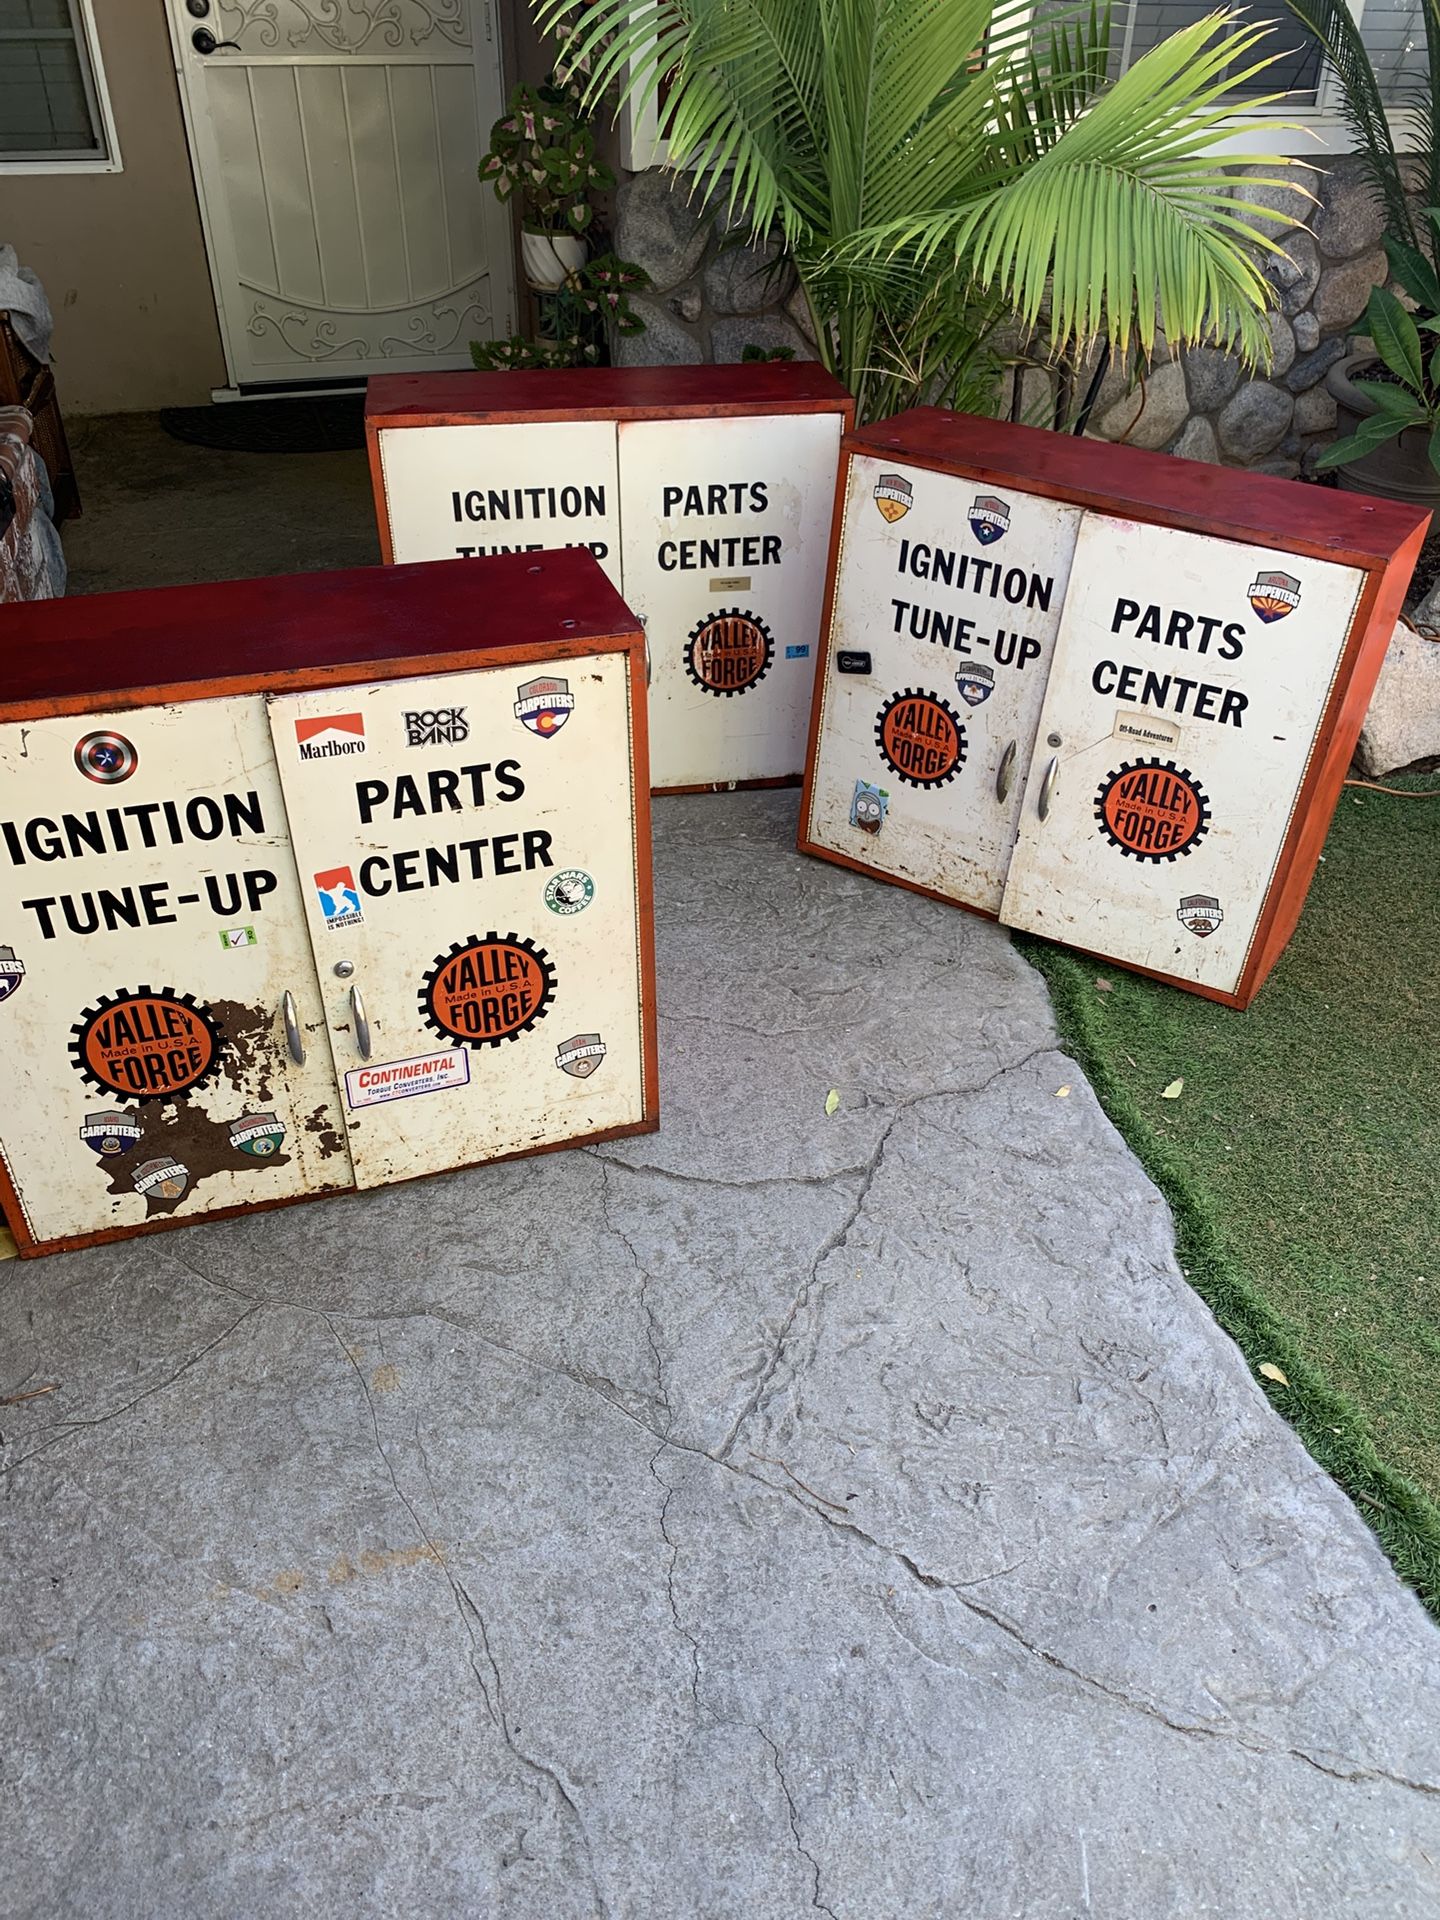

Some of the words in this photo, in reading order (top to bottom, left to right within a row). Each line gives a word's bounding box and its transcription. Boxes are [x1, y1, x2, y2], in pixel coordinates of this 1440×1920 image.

[452, 485, 606, 522] IGNITION
[663, 481, 769, 517] PARTS
[875, 486, 912, 508] CARPENTERS
[970, 508, 1009, 531] CARPENTERS
[657, 535, 782, 571] CENTER
[898, 539, 1054, 612] IGNITION
[1248, 584, 1299, 608] CARPENTERS
[700, 620, 758, 651] VALLEY
[891, 598, 1042, 670] TUNE-UP
[1111, 598, 1246, 660] PARTS
[702, 656, 758, 686] FORGE
[514, 695, 574, 717] CARPENTERS
[1092, 660, 1249, 728] CENTER
[404, 707, 469, 731] ROCK
[891, 728, 913, 739] Made
[894, 703, 952, 743] VALLEY
[299, 739, 366, 760] Marlboro
[407, 726, 469, 746] BAND
[1142, 730, 1174, 743] Adventures
[891, 736, 949, 774] FORGE
[356, 759, 526, 824] PARTS
[1115, 799, 1142, 812] Made
[1120, 773, 1192, 815] VALLEY
[0, 791, 266, 866] IGNITION
[1113, 808, 1185, 850] FORGE
[359, 830, 554, 897] CENTER
[546, 878, 561, 902] STAR
[559, 871, 590, 884] WARS
[22, 869, 278, 939] TUNE-UP
[326, 911, 362, 925] IMPOSSIBLE
[558, 894, 592, 914] COFFEE
[1178, 907, 1224, 920] CARPENTERS
[335, 917, 365, 929] NOTHING!
[443, 949, 530, 994] VALLEY
[445, 992, 477, 1004] Made
[481, 989, 491, 997] in
[495, 980, 535, 993] U.S.A.
[95, 1004, 194, 1049] VALLEY
[449, 989, 532, 1034] FORGE
[101, 1046, 137, 1059] Made
[142, 1044, 153, 1052] in
[157, 1037, 202, 1050] U.S.A.
[556, 1044, 606, 1067] CARPENTERS
[107, 1046, 203, 1090] FORGE
[358, 1056, 456, 1088] CONTINENTAL
[80, 1125, 141, 1139] CARPENTERS
[229, 1122, 286, 1147] CARPENTERS
[133, 1163, 189, 1194] CARPENTERS
